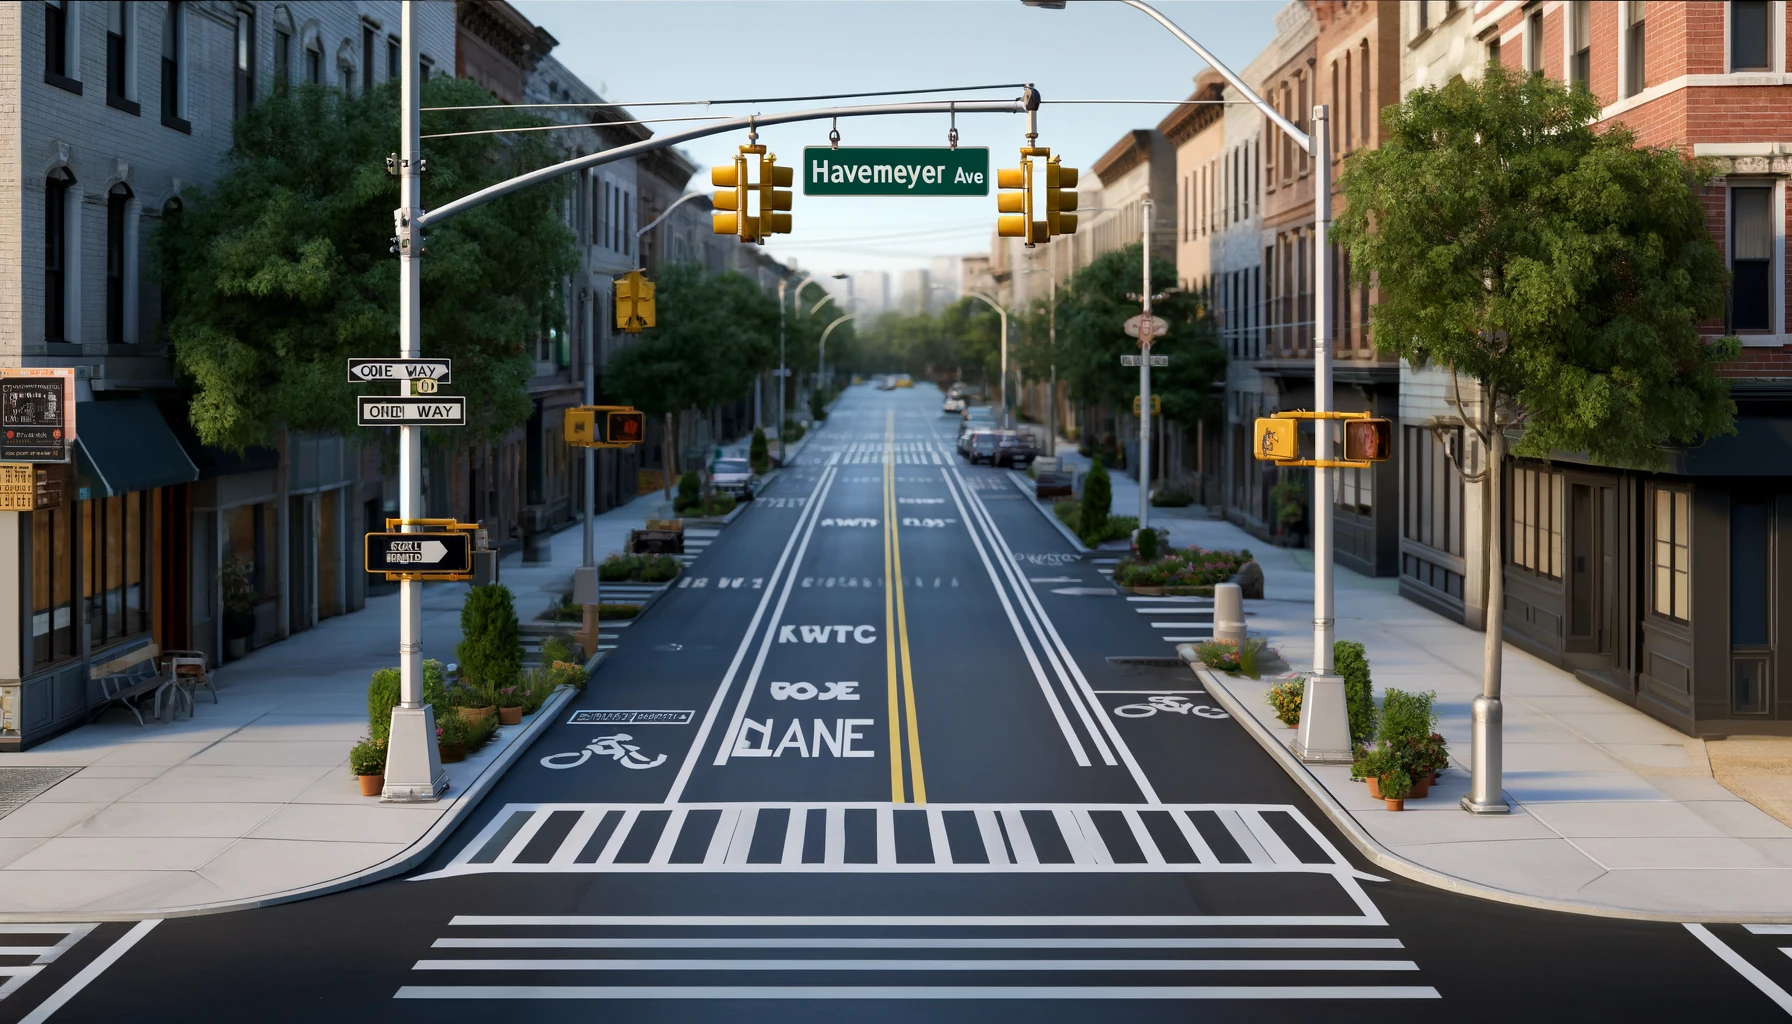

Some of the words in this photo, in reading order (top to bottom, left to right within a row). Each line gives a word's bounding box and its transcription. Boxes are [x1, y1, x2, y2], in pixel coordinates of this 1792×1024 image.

[811, 159, 946, 190] Havemeyer
[953, 166, 984, 185] Ave
[417, 405, 453, 418] WAY
[778, 624, 877, 645] KWTC
